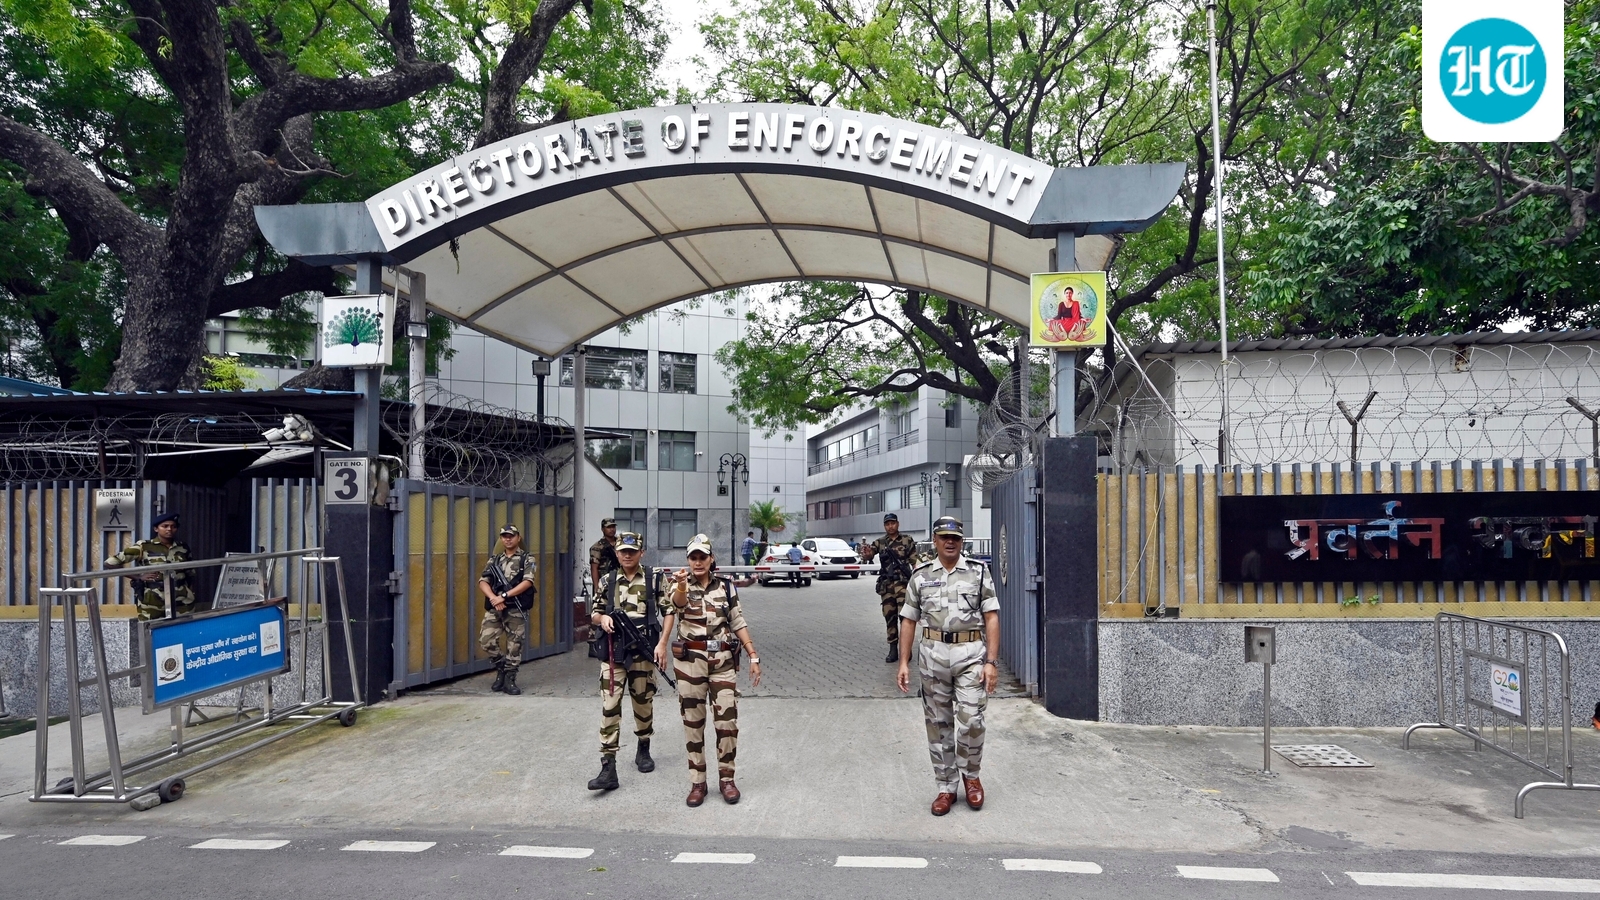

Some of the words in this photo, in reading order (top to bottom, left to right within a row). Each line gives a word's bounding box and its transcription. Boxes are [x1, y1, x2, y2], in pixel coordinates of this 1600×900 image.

[379, 119, 646, 236] DIRECTORATE
[660, 113, 710, 152] OF
[728, 111, 1034, 204] ENFORCEMENT
[334, 468, 358, 500] 3
[1281, 500, 1445, 561] प्रवर्तन
